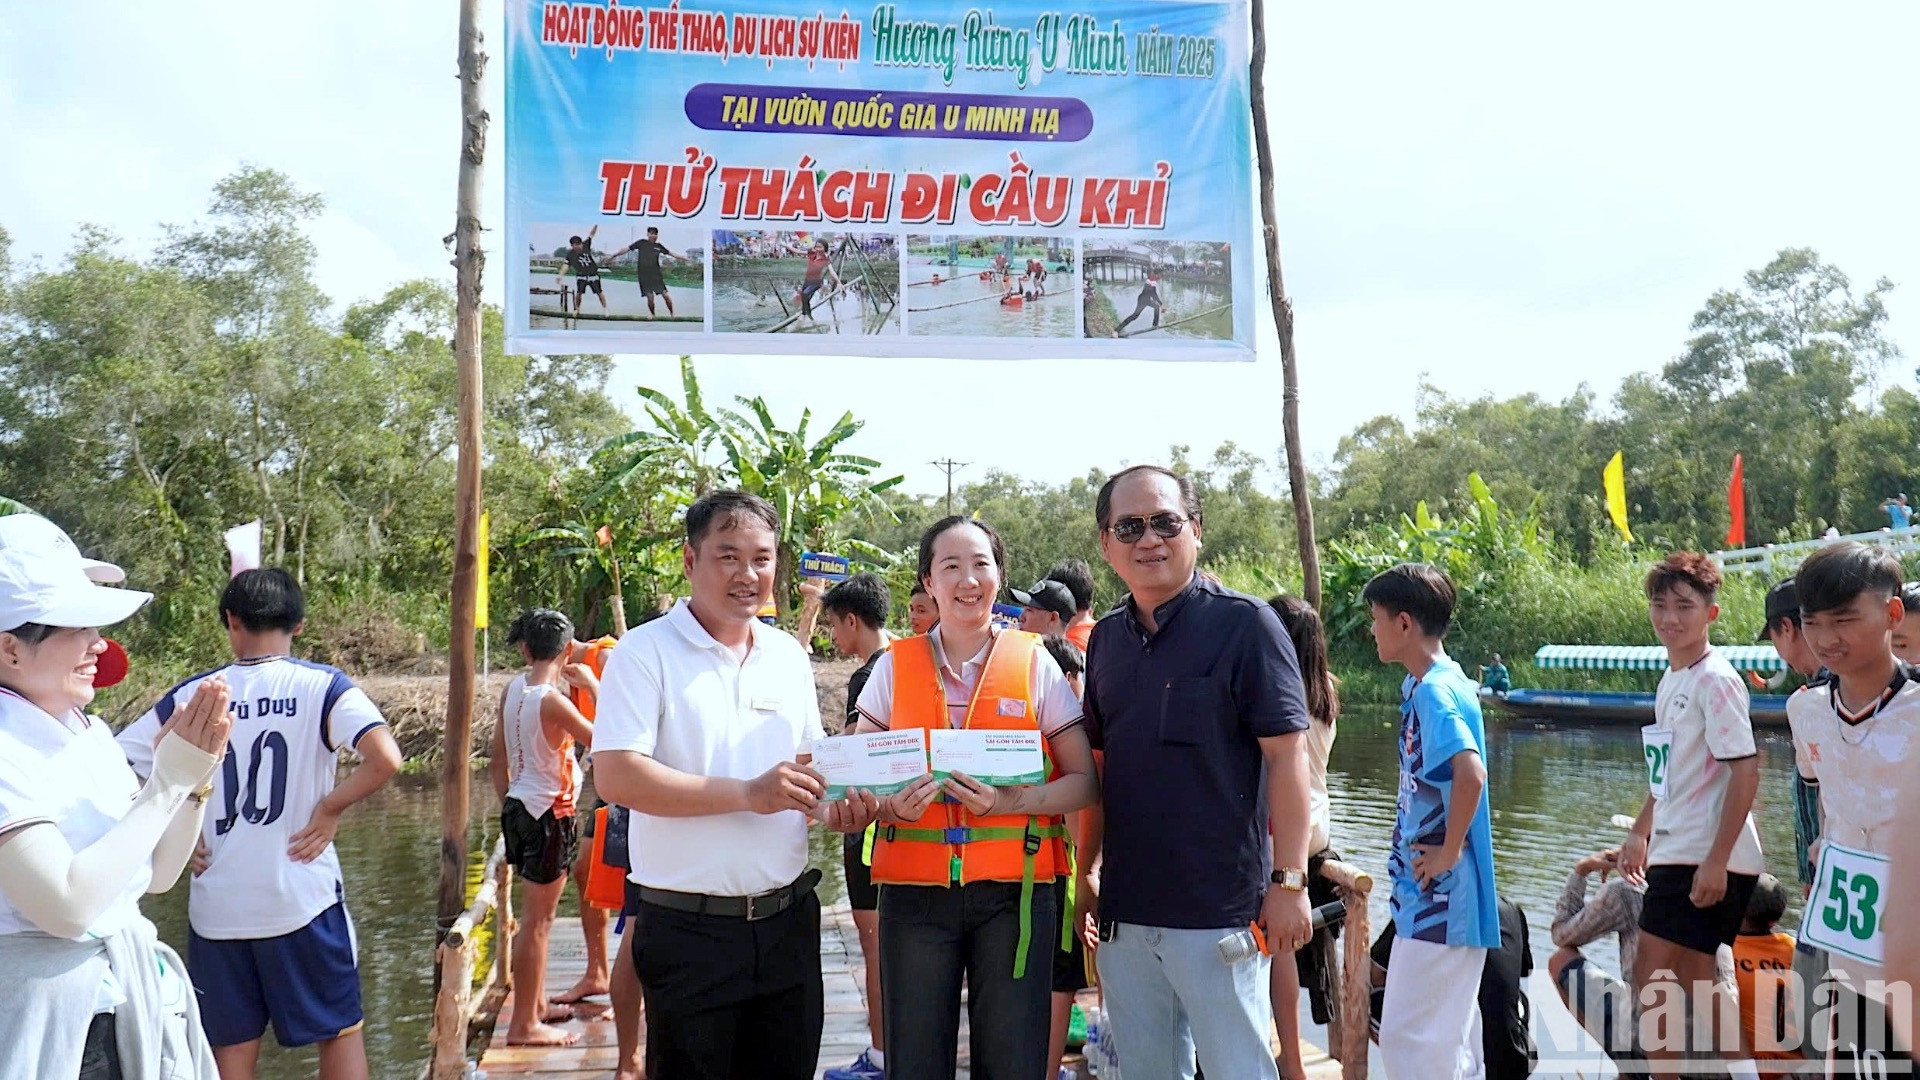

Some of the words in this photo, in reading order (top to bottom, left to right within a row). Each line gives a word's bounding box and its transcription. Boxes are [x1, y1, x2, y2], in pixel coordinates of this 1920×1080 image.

[543, 4, 591, 56] HOẠT
[593, 0, 644, 58] ĐỘNG
[682, 12, 728, 60] THAO,
[733, 16, 757, 55] DU
[760, 17, 796, 67] LỊCH
[797, 13, 822, 69] SỰ
[823, 13, 860, 70] KIỆN
[872, 5, 957, 83] Hương
[963, 8, 1031, 86] Rừng
[1035, 13, 1061, 70] U
[1067, 14, 1129, 74] Minh
[1136, 26, 1174, 75] NĂM
[1176, 36, 1216, 77] 2025
[721, 95, 759, 129] TẠI
[764, 92, 827, 126] VƯỜN
[831, 93, 895, 130] QUỐC
[899, 102, 937, 131] GIA
[943, 105, 961, 132] U
[964, 105, 1026, 133] MINH
[1029, 107, 1060, 140] HẠ
[600, 146, 715, 216] THỬ
[719, 154, 892, 220] THÁCH
[900, 172, 957, 222] ĐI
[968, 150, 1071, 223] CẦU
[1079, 161, 1171, 227] KHỈ
[820, 560, 846, 574] THÁCH
[257, 697, 297, 717] Duy
[216, 729, 288, 835] 10
[1823, 865, 1879, 940] 53
